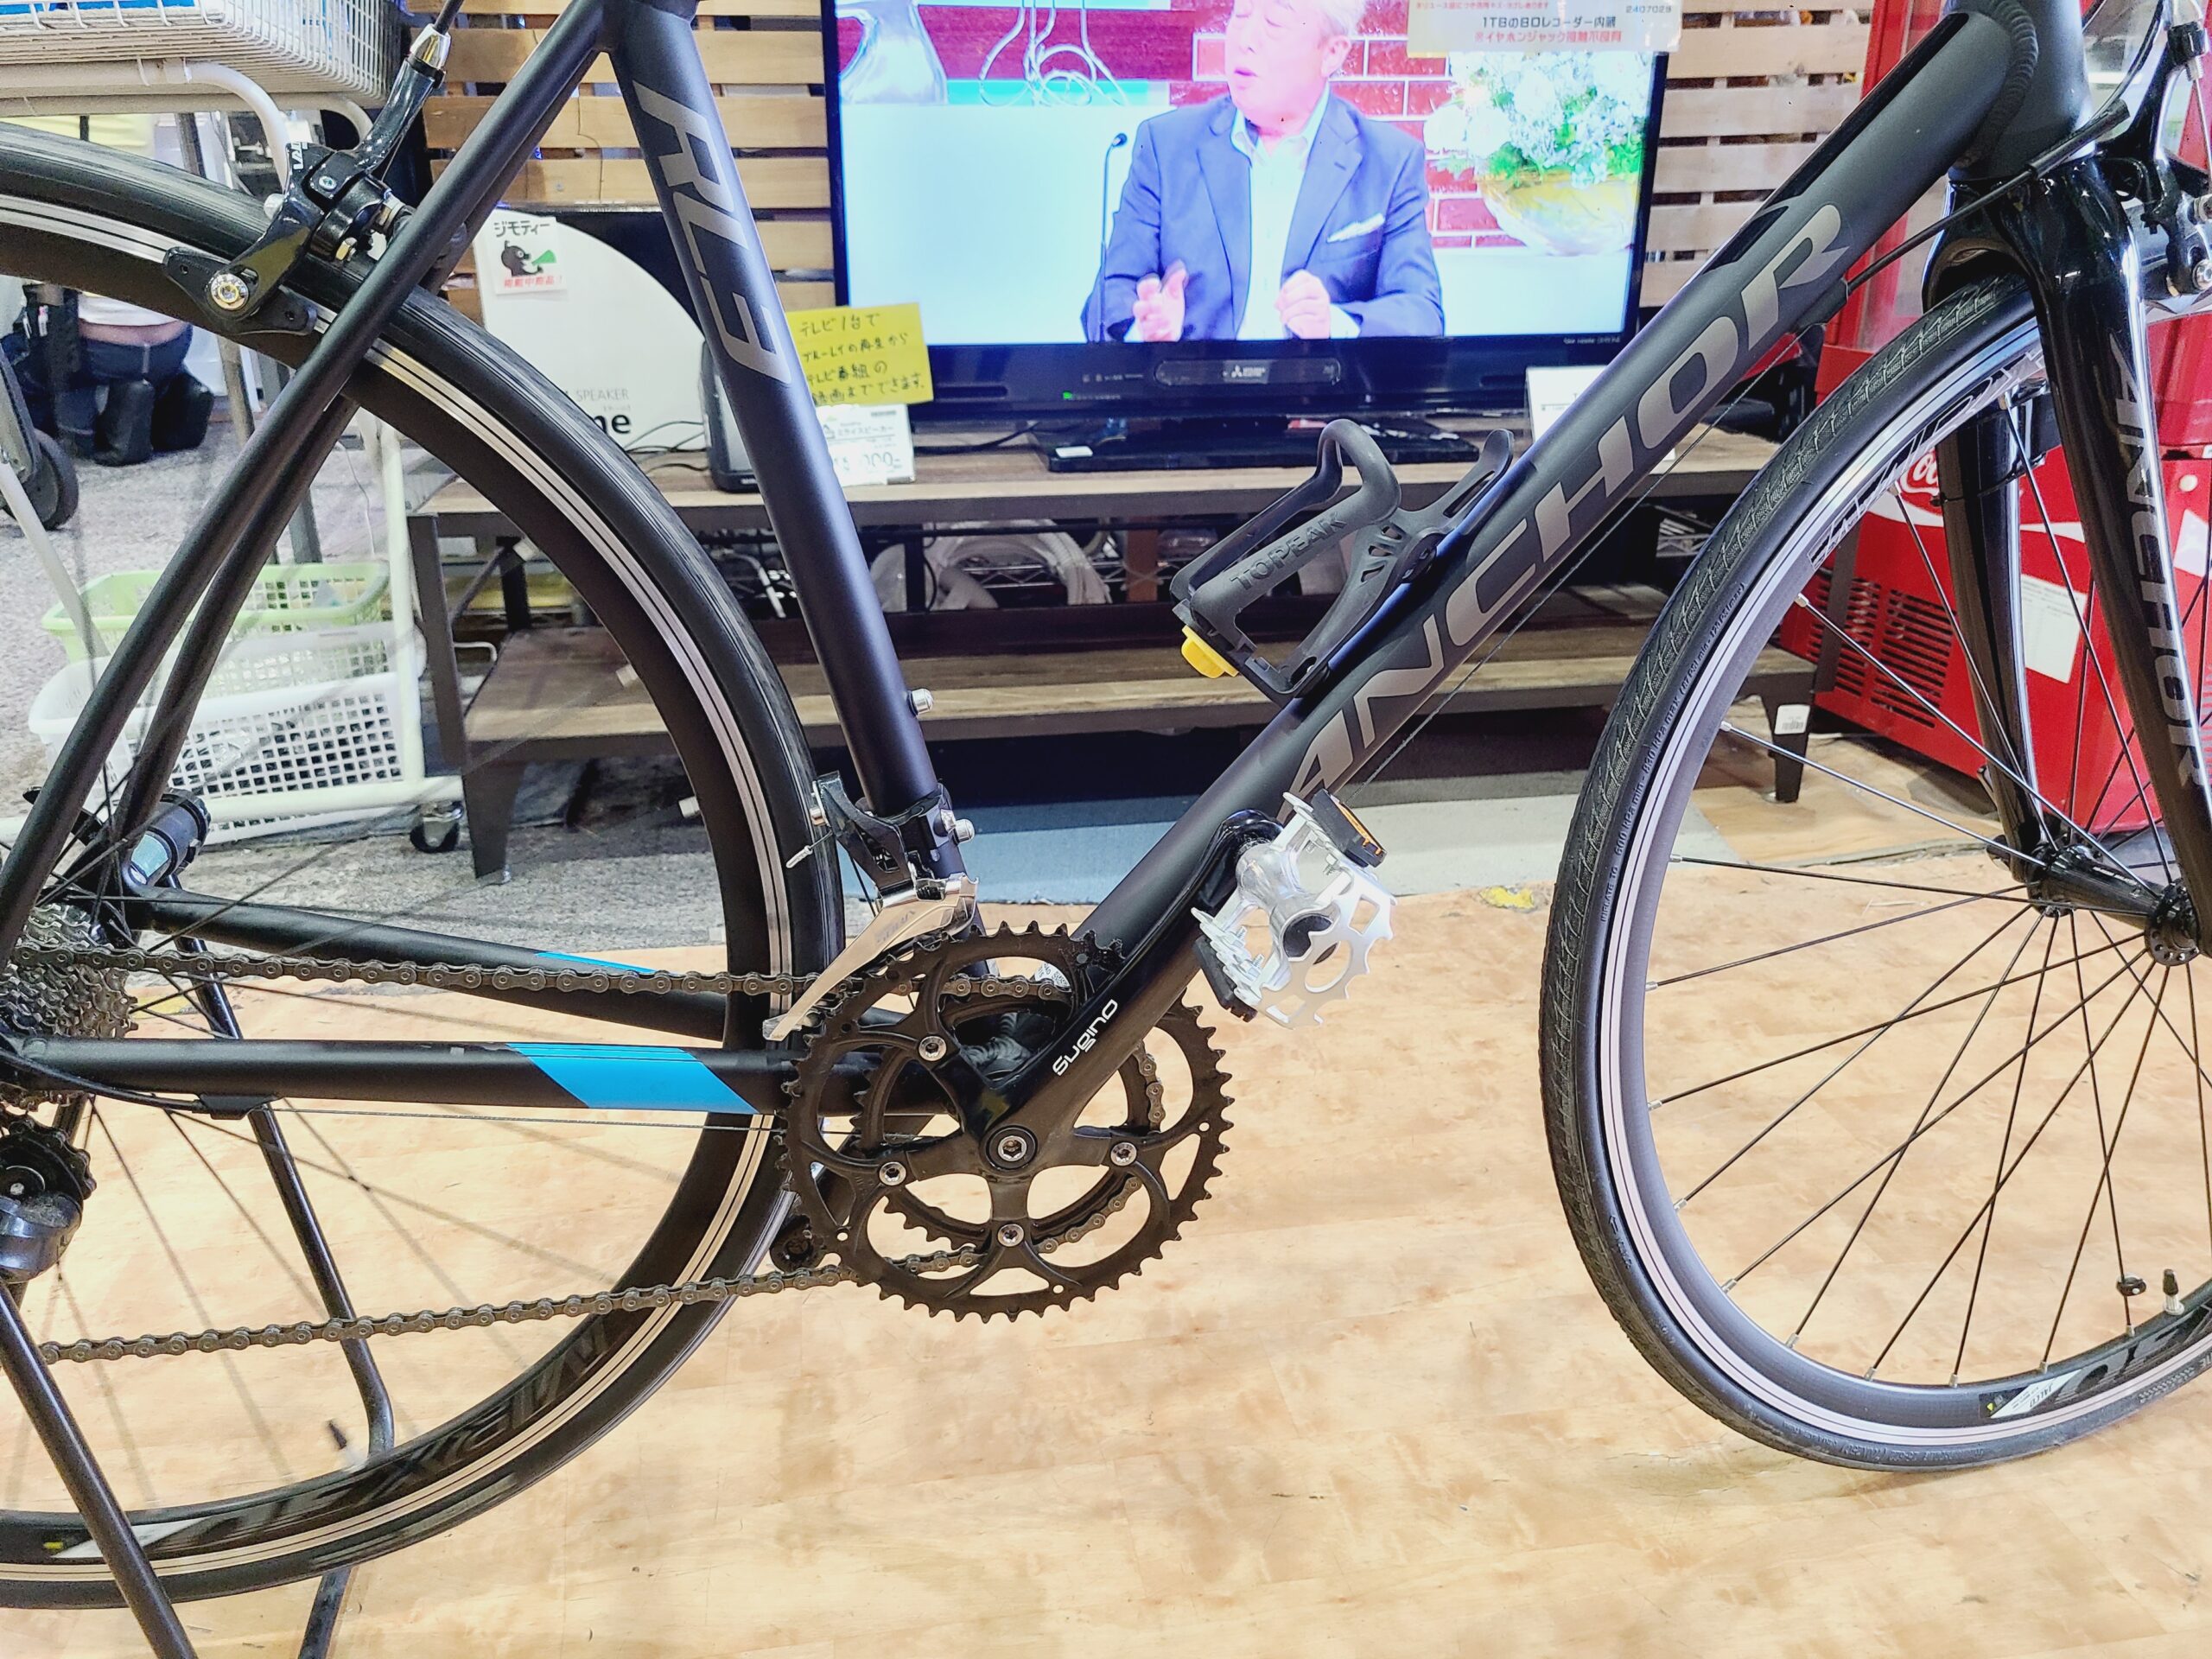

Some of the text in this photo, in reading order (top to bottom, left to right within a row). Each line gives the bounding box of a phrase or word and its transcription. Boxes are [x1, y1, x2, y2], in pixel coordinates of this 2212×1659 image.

[493, 220, 550, 238] ジモティー
[632, 79, 792, 385] RL3
[575, 387, 629, 402] SPEAKER
[1230, 512, 1347, 590] TOPEAK
[1280, 204, 1850, 823] ANCHOR
[2109, 332, 2207, 787] ANCHOR
[1612, 830, 1629, 856] 600
[1052, 999, 1118, 1077] Sugino
